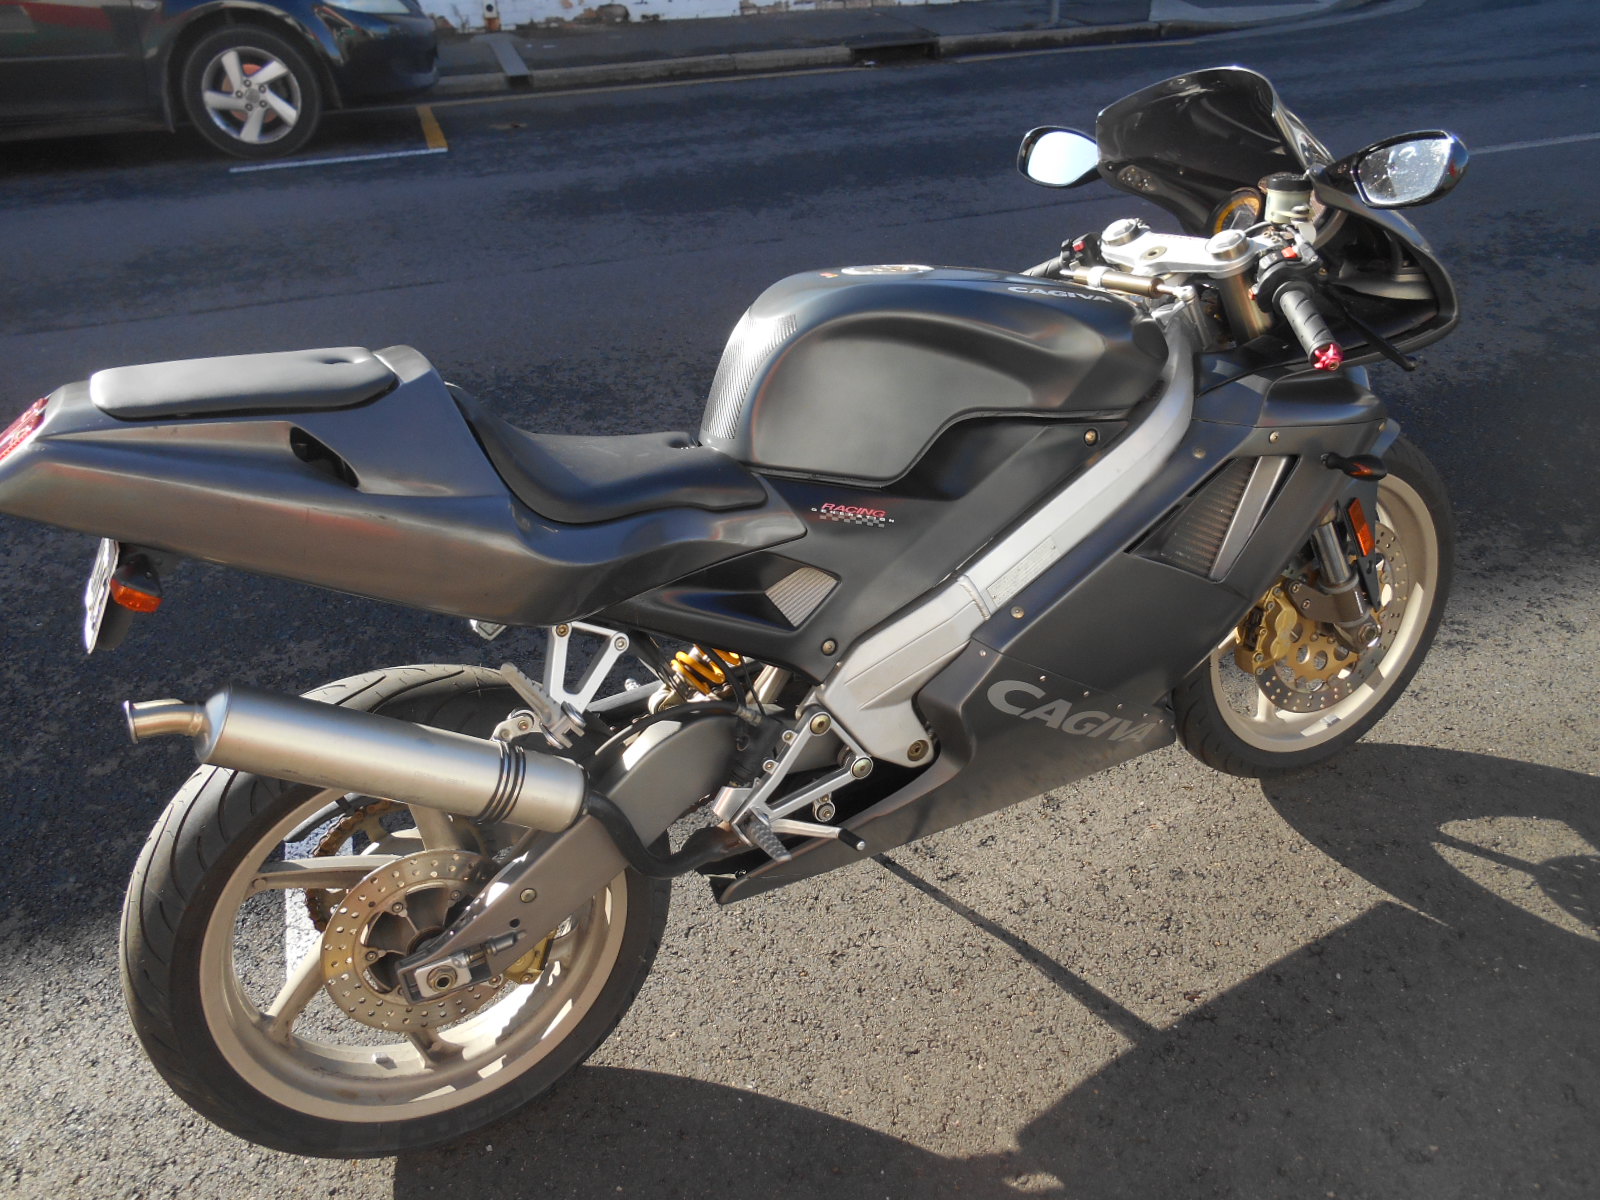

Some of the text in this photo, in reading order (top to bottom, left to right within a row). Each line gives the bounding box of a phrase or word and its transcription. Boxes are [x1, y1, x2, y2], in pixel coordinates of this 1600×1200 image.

[1007, 286, 1113, 303] CAGIVA
[821, 502, 887, 517] RACING
[987, 679, 1157, 743] CAGIVA
